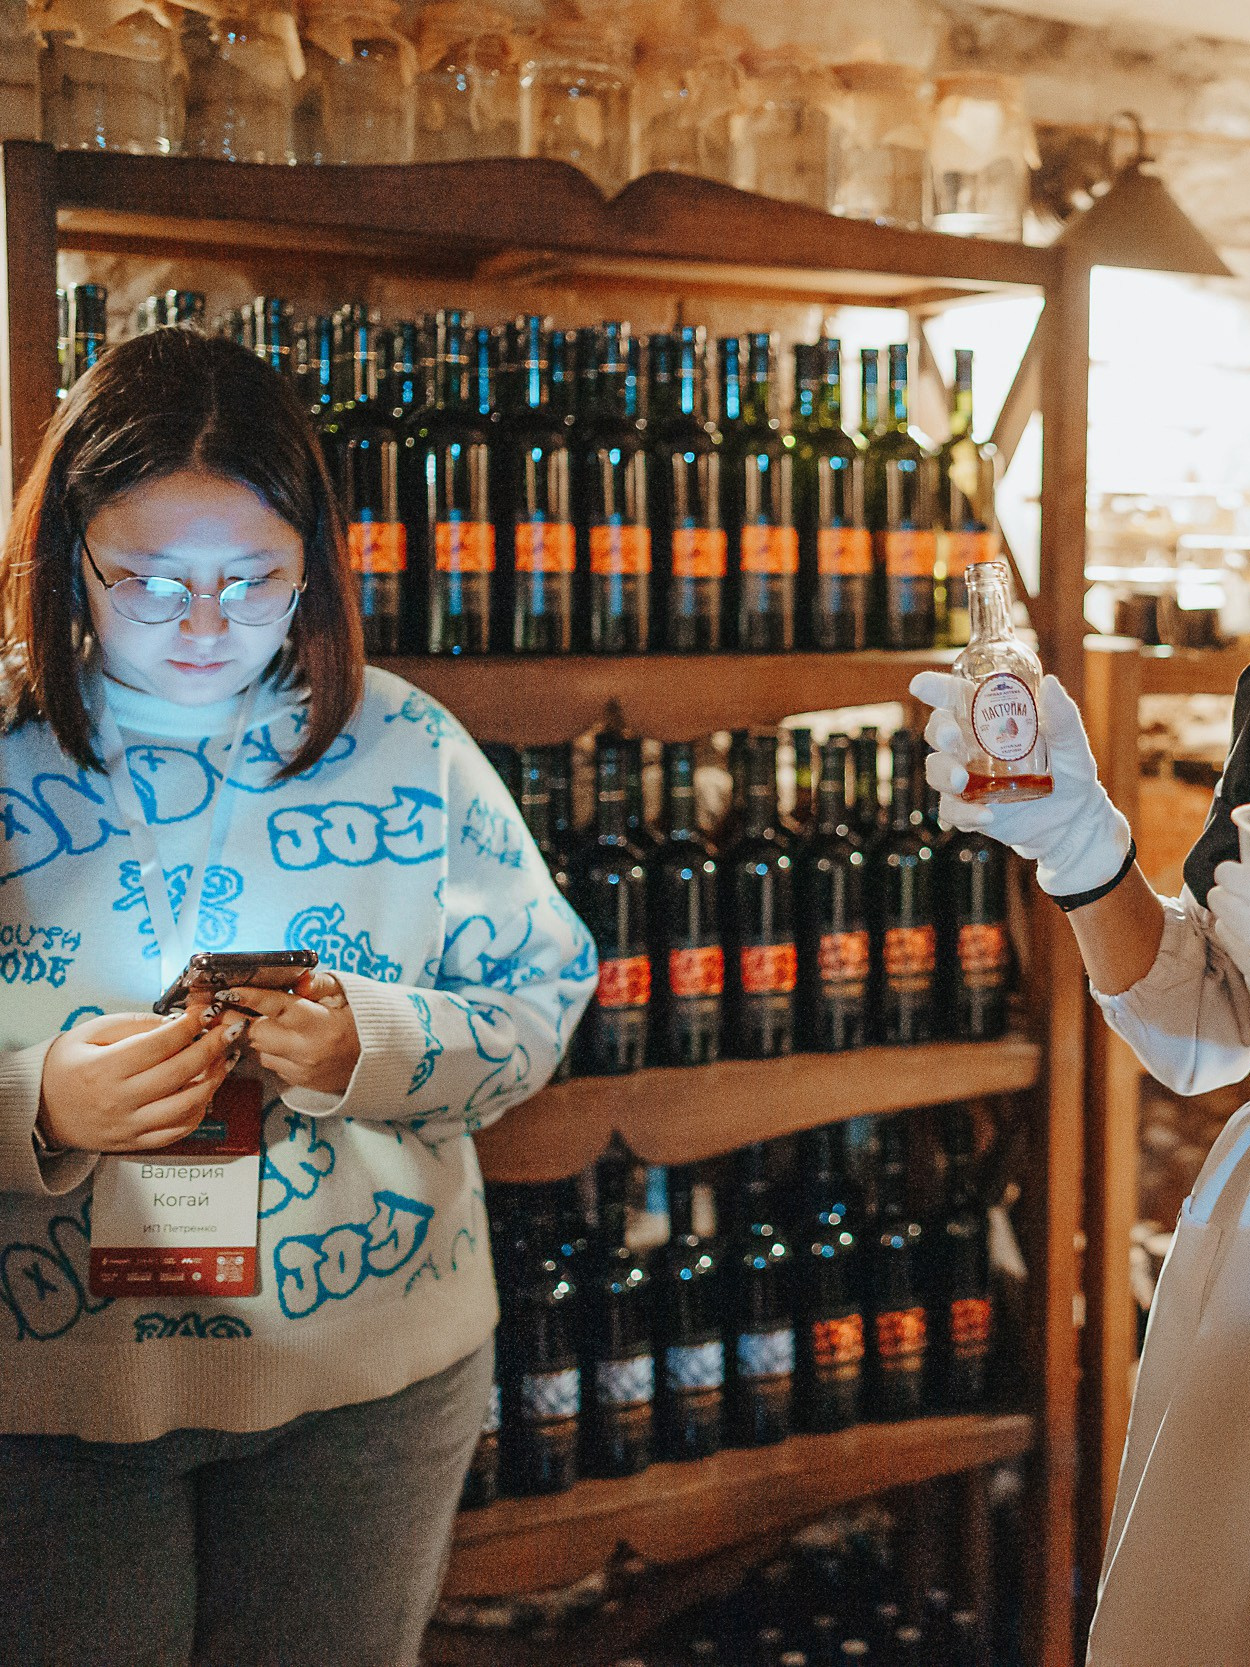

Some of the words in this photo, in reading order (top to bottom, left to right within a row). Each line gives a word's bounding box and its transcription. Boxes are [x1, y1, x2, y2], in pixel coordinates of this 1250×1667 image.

[981, 701, 1027, 722] НАСТОЙКА
[268, 786, 446, 871] JOY
[141, 1165, 224, 1182] Валерия
[153, 1192, 210, 1207] Когай
[143, 1224, 161, 1233] ИП
[163, 1223, 218, 1235] Петренко
[273, 1190, 434, 1319] JOY
